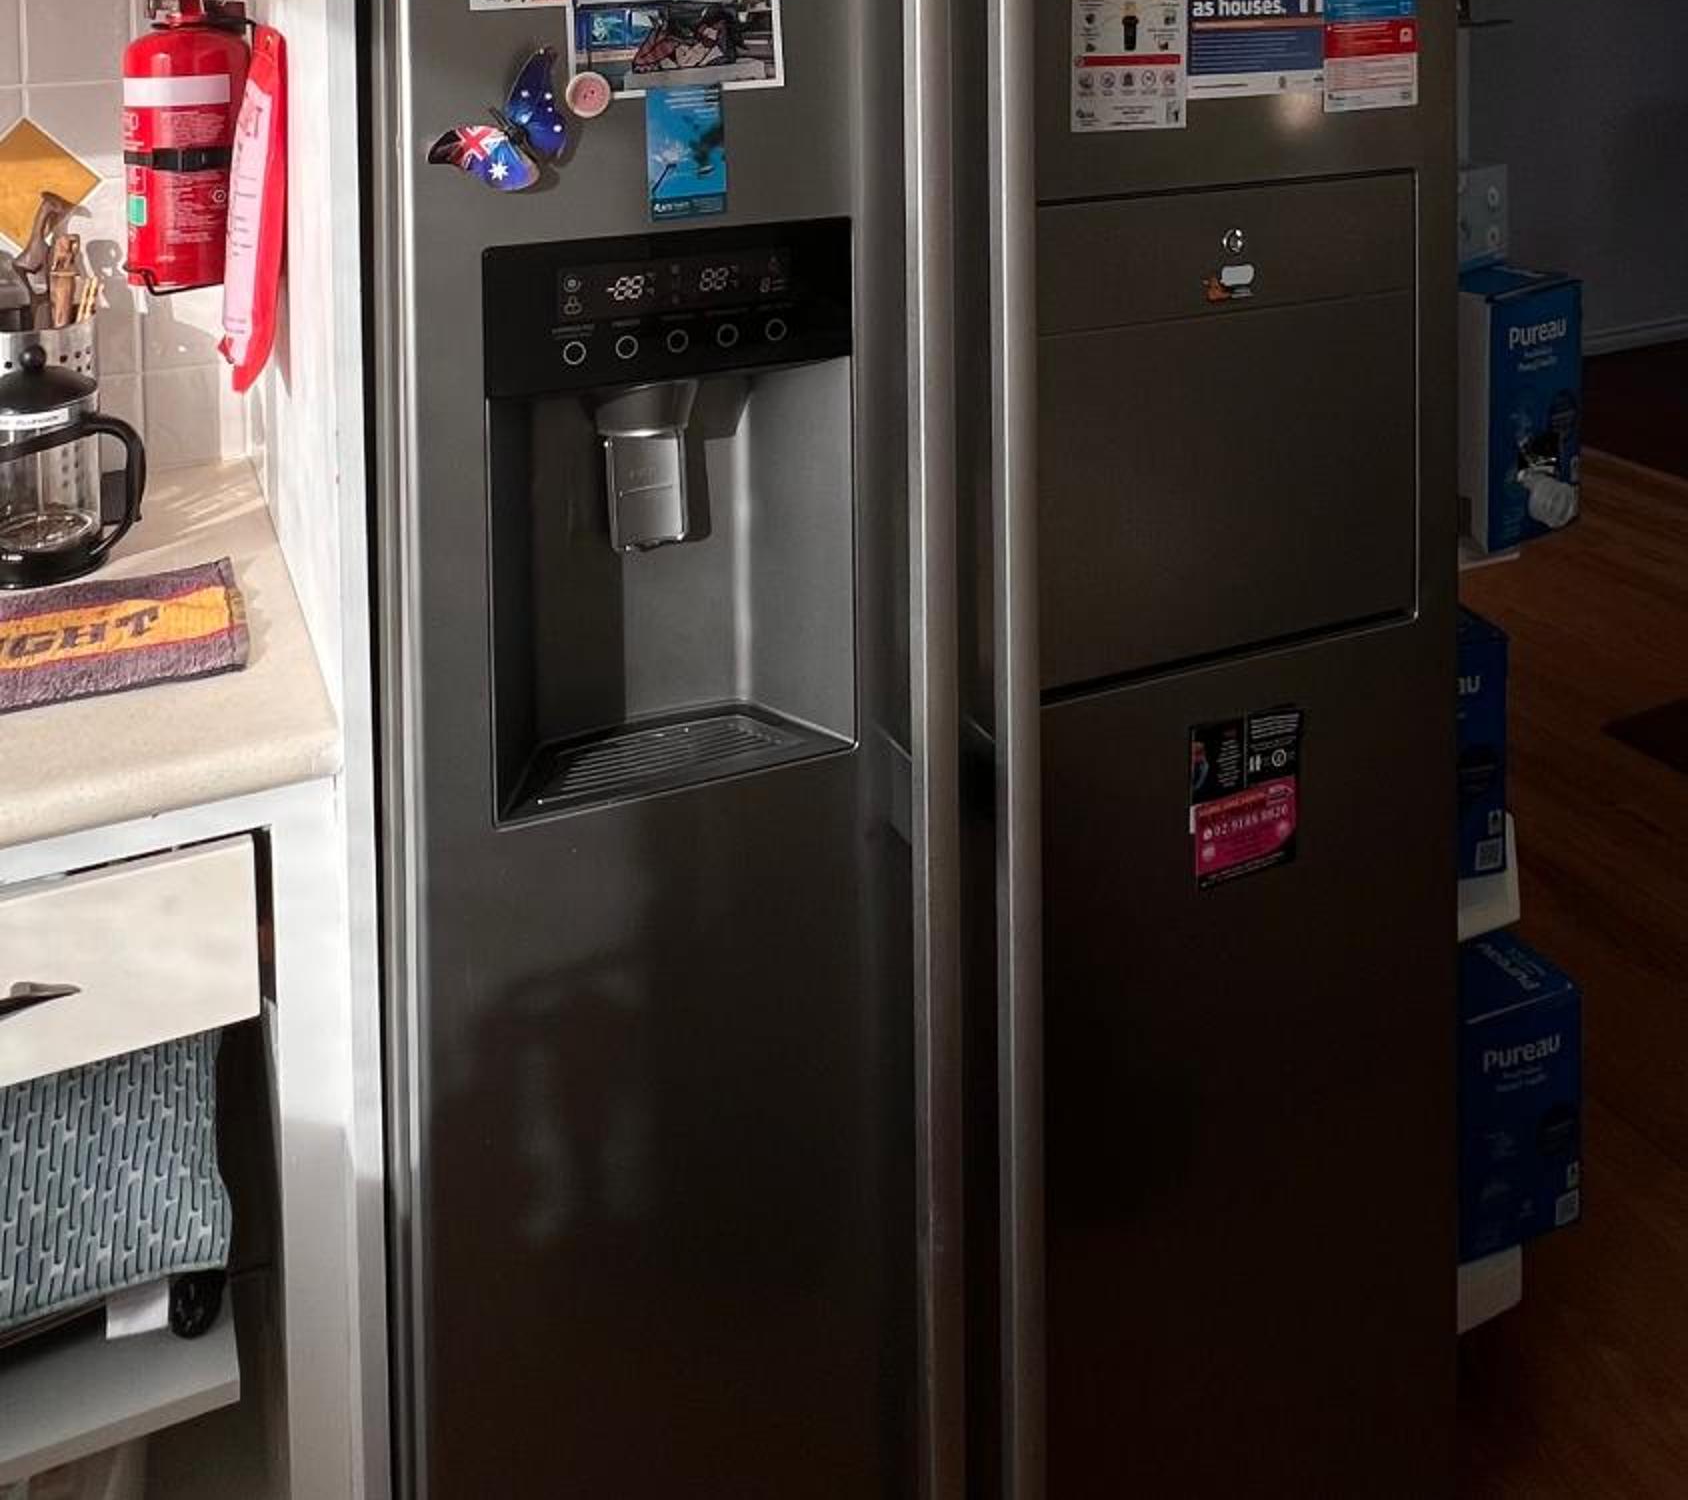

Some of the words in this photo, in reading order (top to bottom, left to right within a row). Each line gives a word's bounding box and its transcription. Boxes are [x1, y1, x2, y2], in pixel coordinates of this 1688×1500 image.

[1192, 1, 1215, 17] as
[1508, 316, 1568, 351] Pureau
[1482, 1032, 1561, 1074] Pureau
